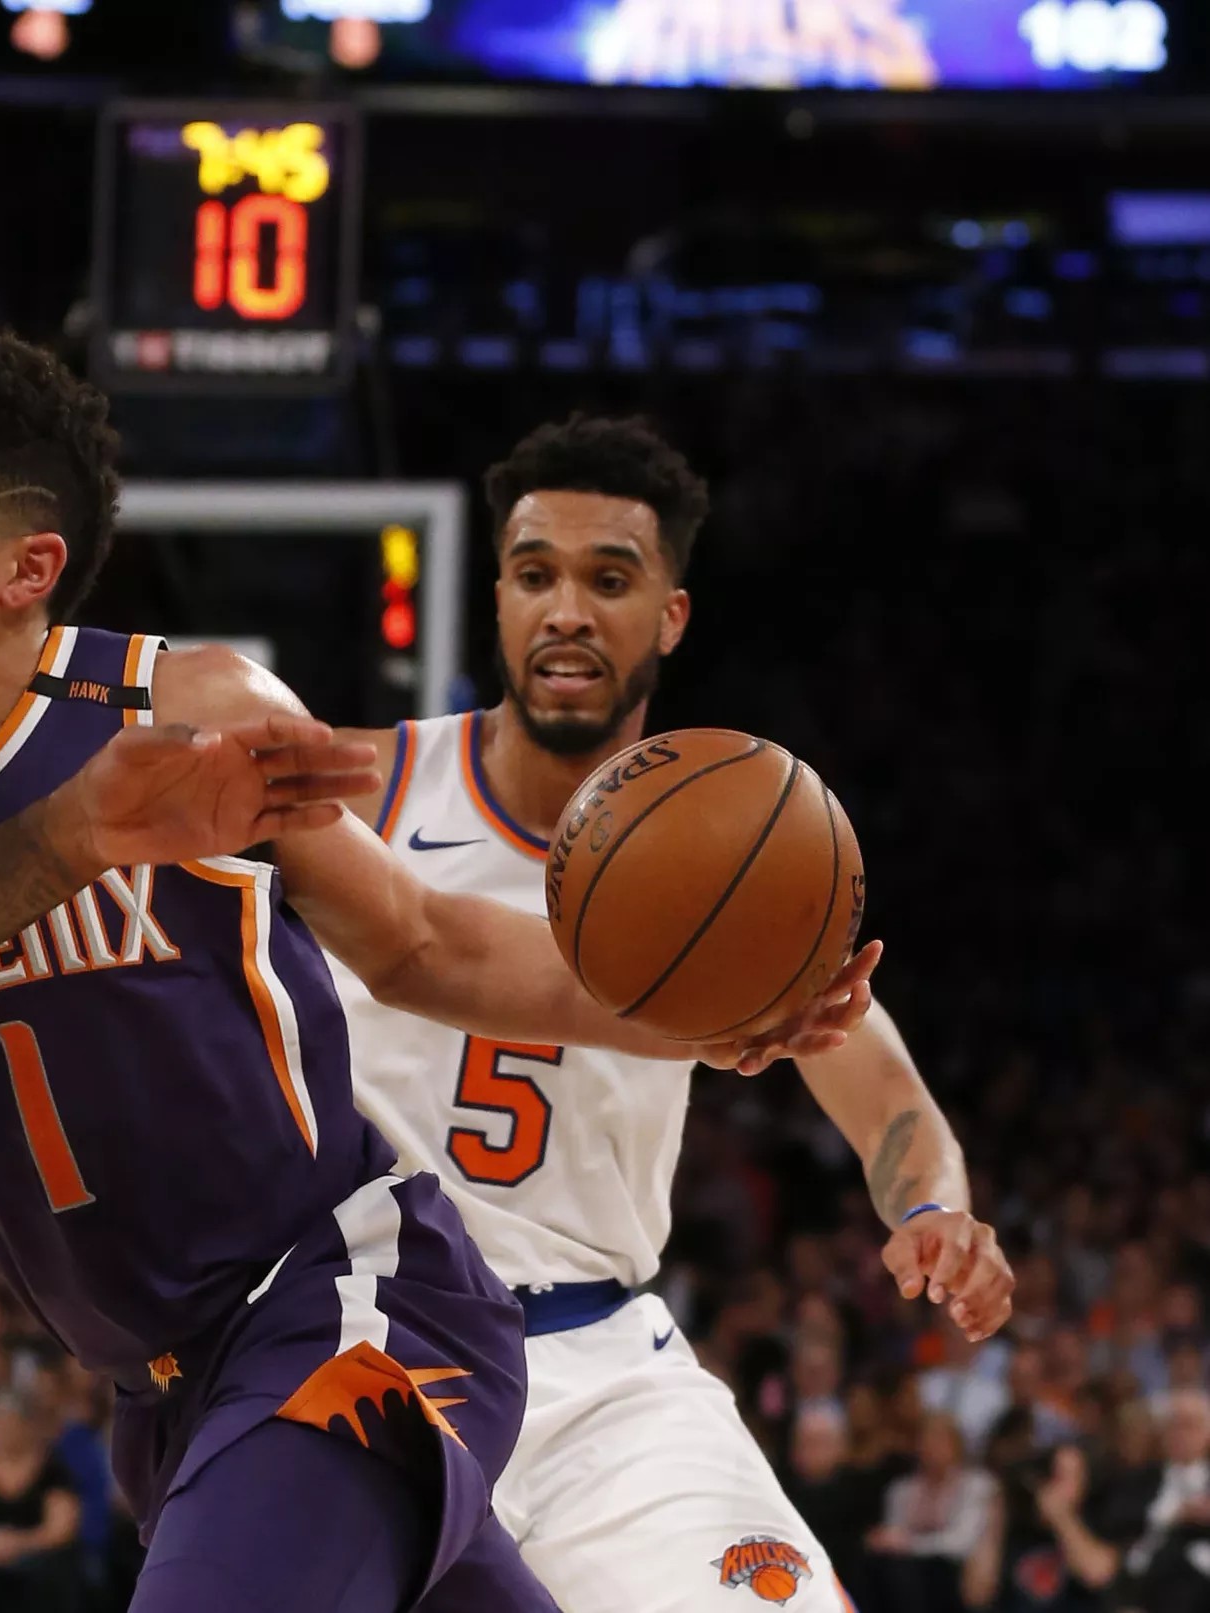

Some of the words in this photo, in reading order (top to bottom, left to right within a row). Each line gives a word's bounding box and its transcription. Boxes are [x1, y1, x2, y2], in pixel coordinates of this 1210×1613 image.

[194, 193, 308, 321] 10
[68, 680, 111, 704] HAWK
[547, 739, 680, 923] SPALDING
[446, 1034, 564, 1188] 5
[719, 1542, 812, 1586] KNICKS
